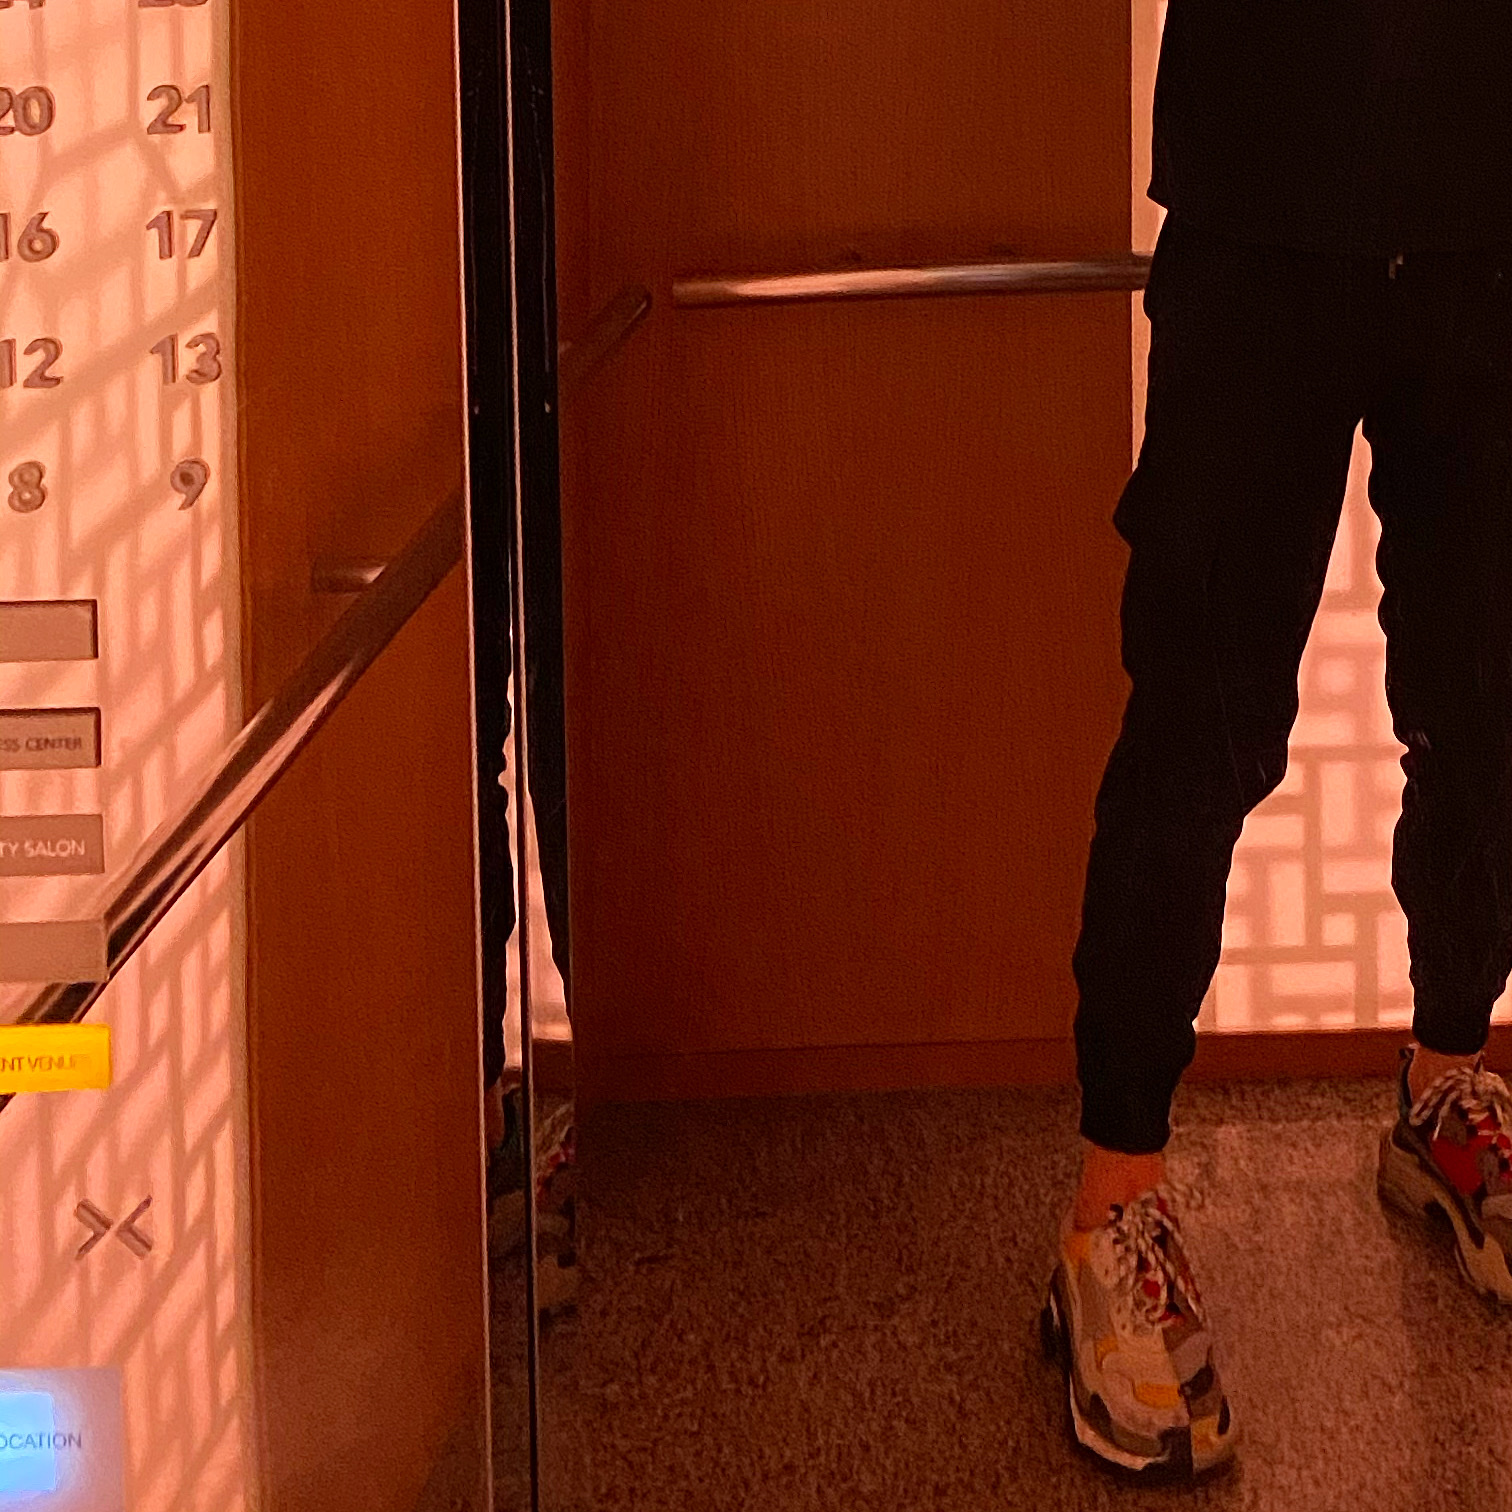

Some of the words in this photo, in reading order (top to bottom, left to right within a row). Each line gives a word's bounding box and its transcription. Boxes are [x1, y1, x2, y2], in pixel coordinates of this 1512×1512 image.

[146, 84, 211, 135] 21
[145, 208, 218, 260] 17
[149, 332, 223, 385] 13
[7, 460, 48, 514] 8
[169, 457, 211, 511] 9
[24, 839, 86, 858] SALON
